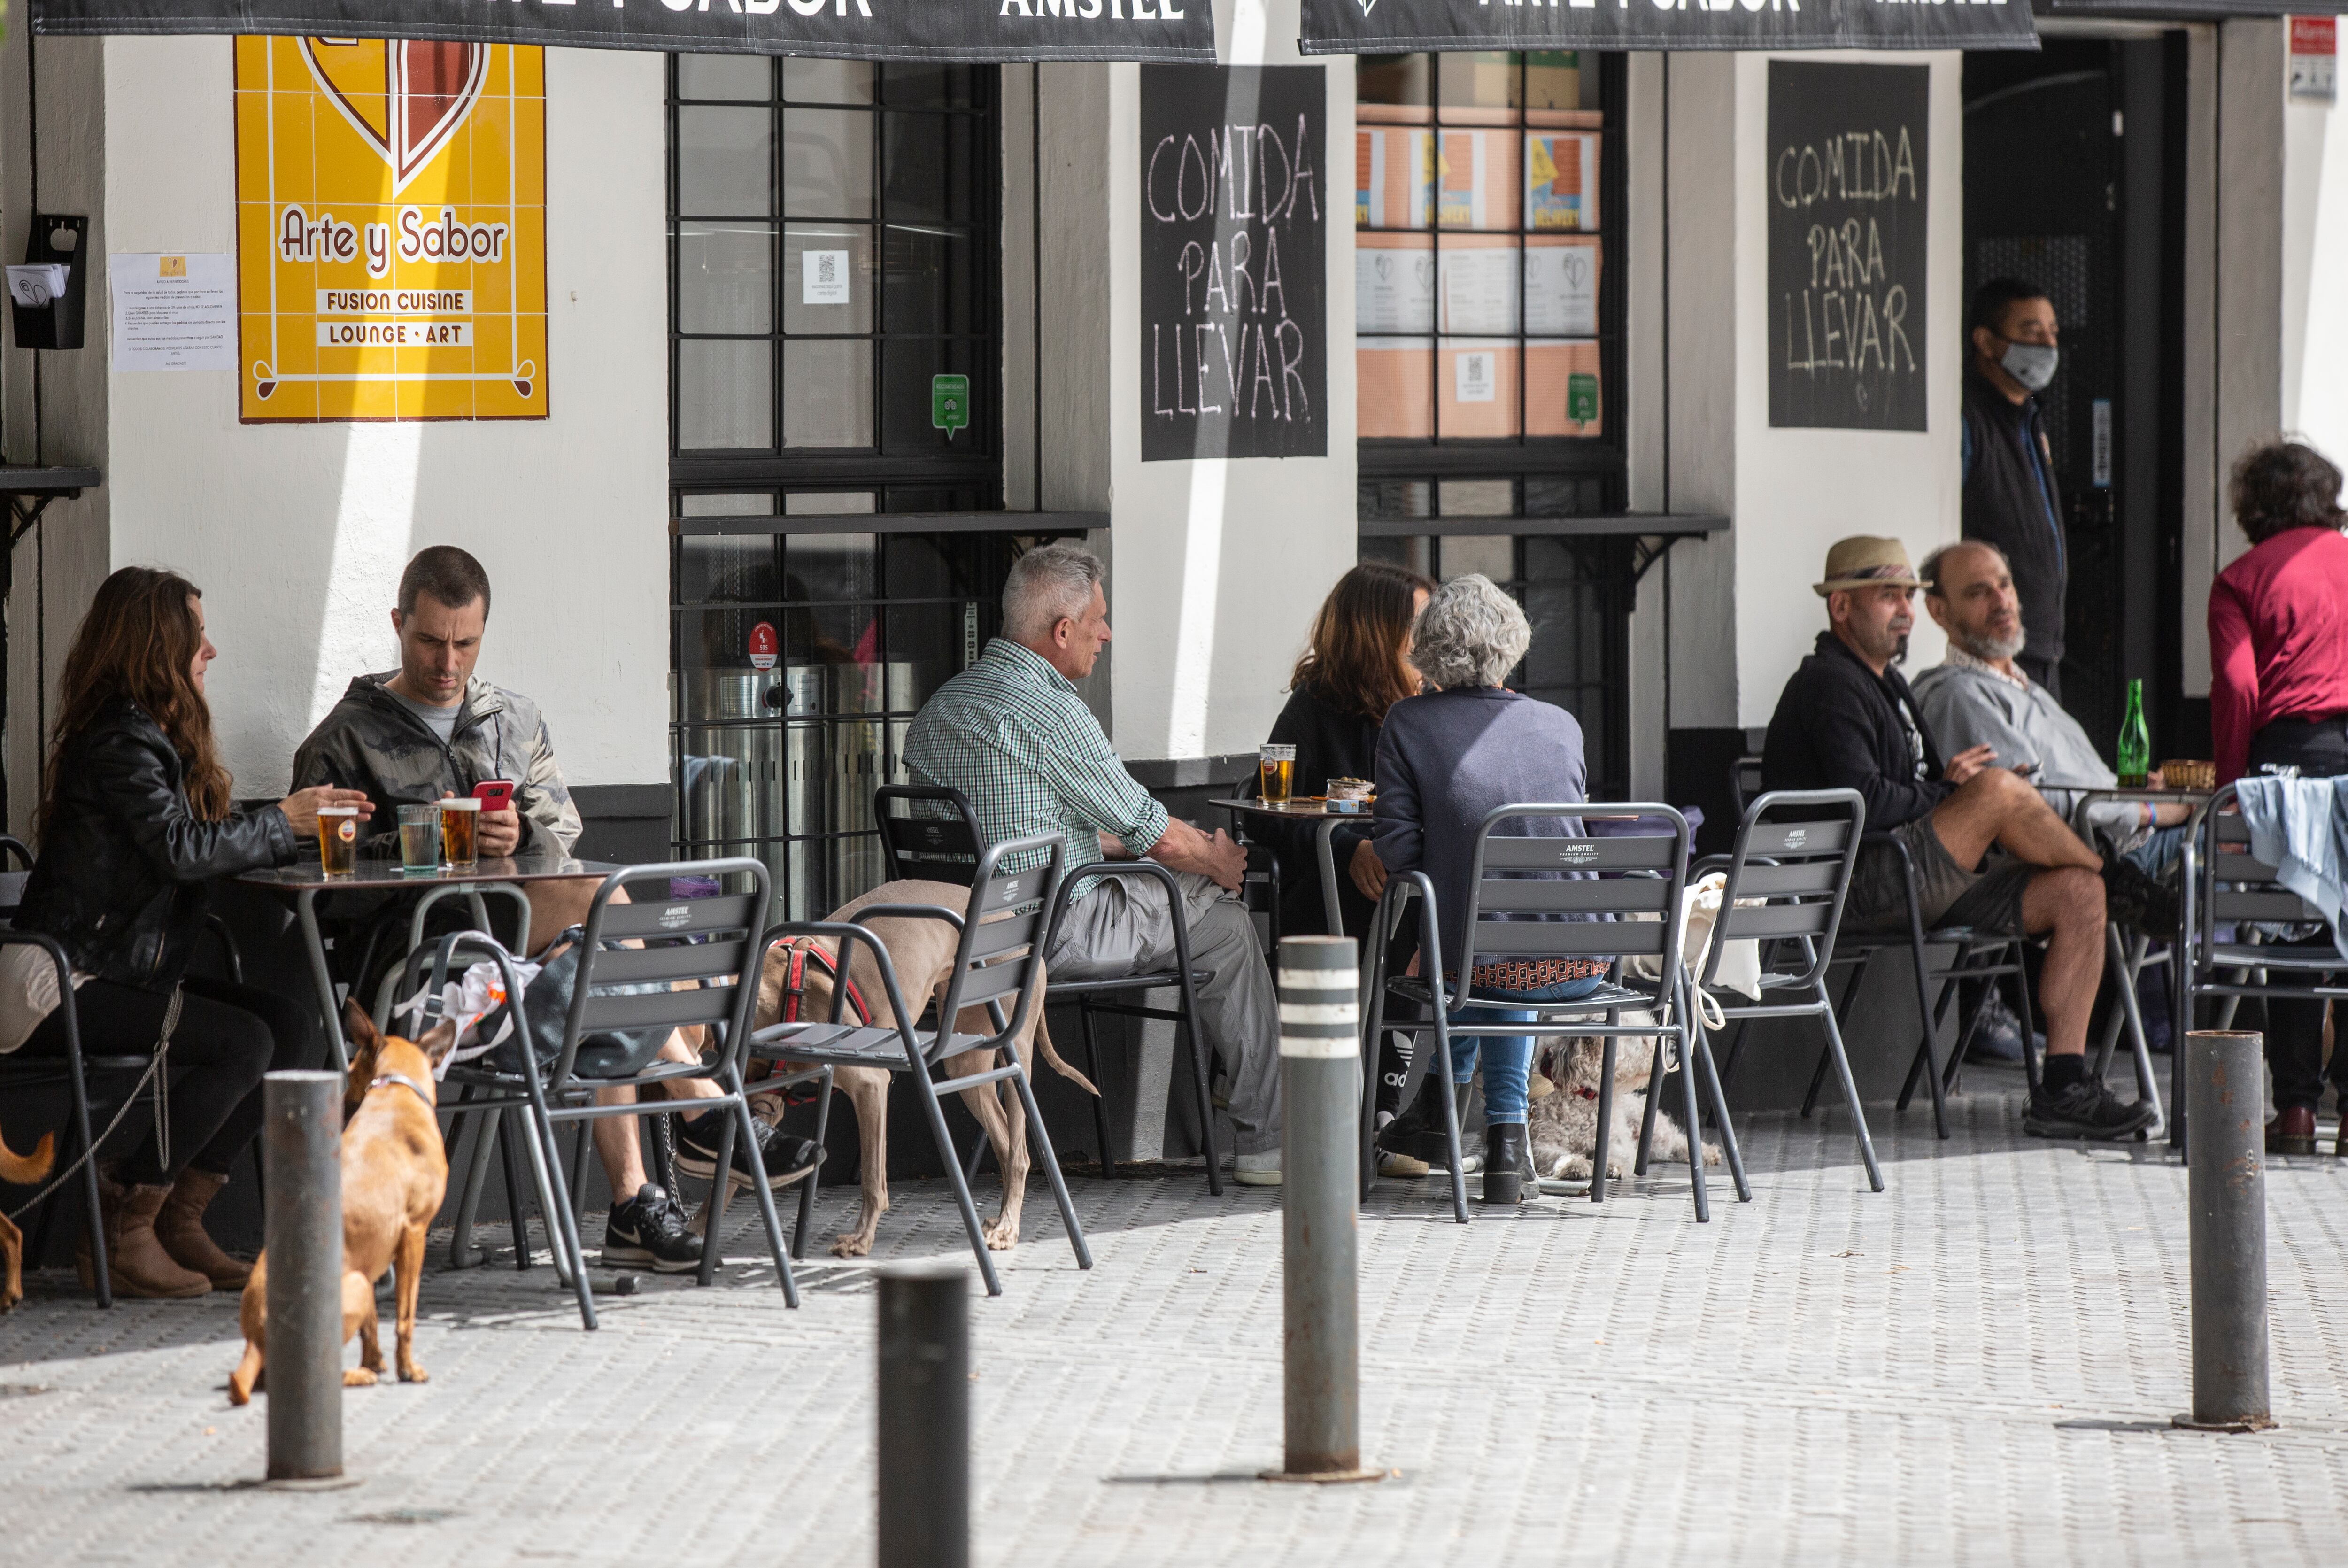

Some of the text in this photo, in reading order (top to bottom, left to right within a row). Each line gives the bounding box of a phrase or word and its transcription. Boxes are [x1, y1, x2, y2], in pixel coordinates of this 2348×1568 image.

[1148, 113, 1319, 224] COMIDA
[1776, 125, 1916, 209] COMIDA
[283, 210, 504, 273] Arte y Sabor
[1177, 226, 1287, 316] PARA
[1807, 217, 1885, 289] PARA
[327, 292, 464, 310] FUSION CUISINE
[330, 325, 462, 343] LOUNGE ART
[1785, 284, 1916, 373] LLEVAR
[1154, 319, 1312, 421] LLEVAR
[664, 906, 689, 917] AMSTEL
[1006, 880, 1019, 890] AMSTEL
